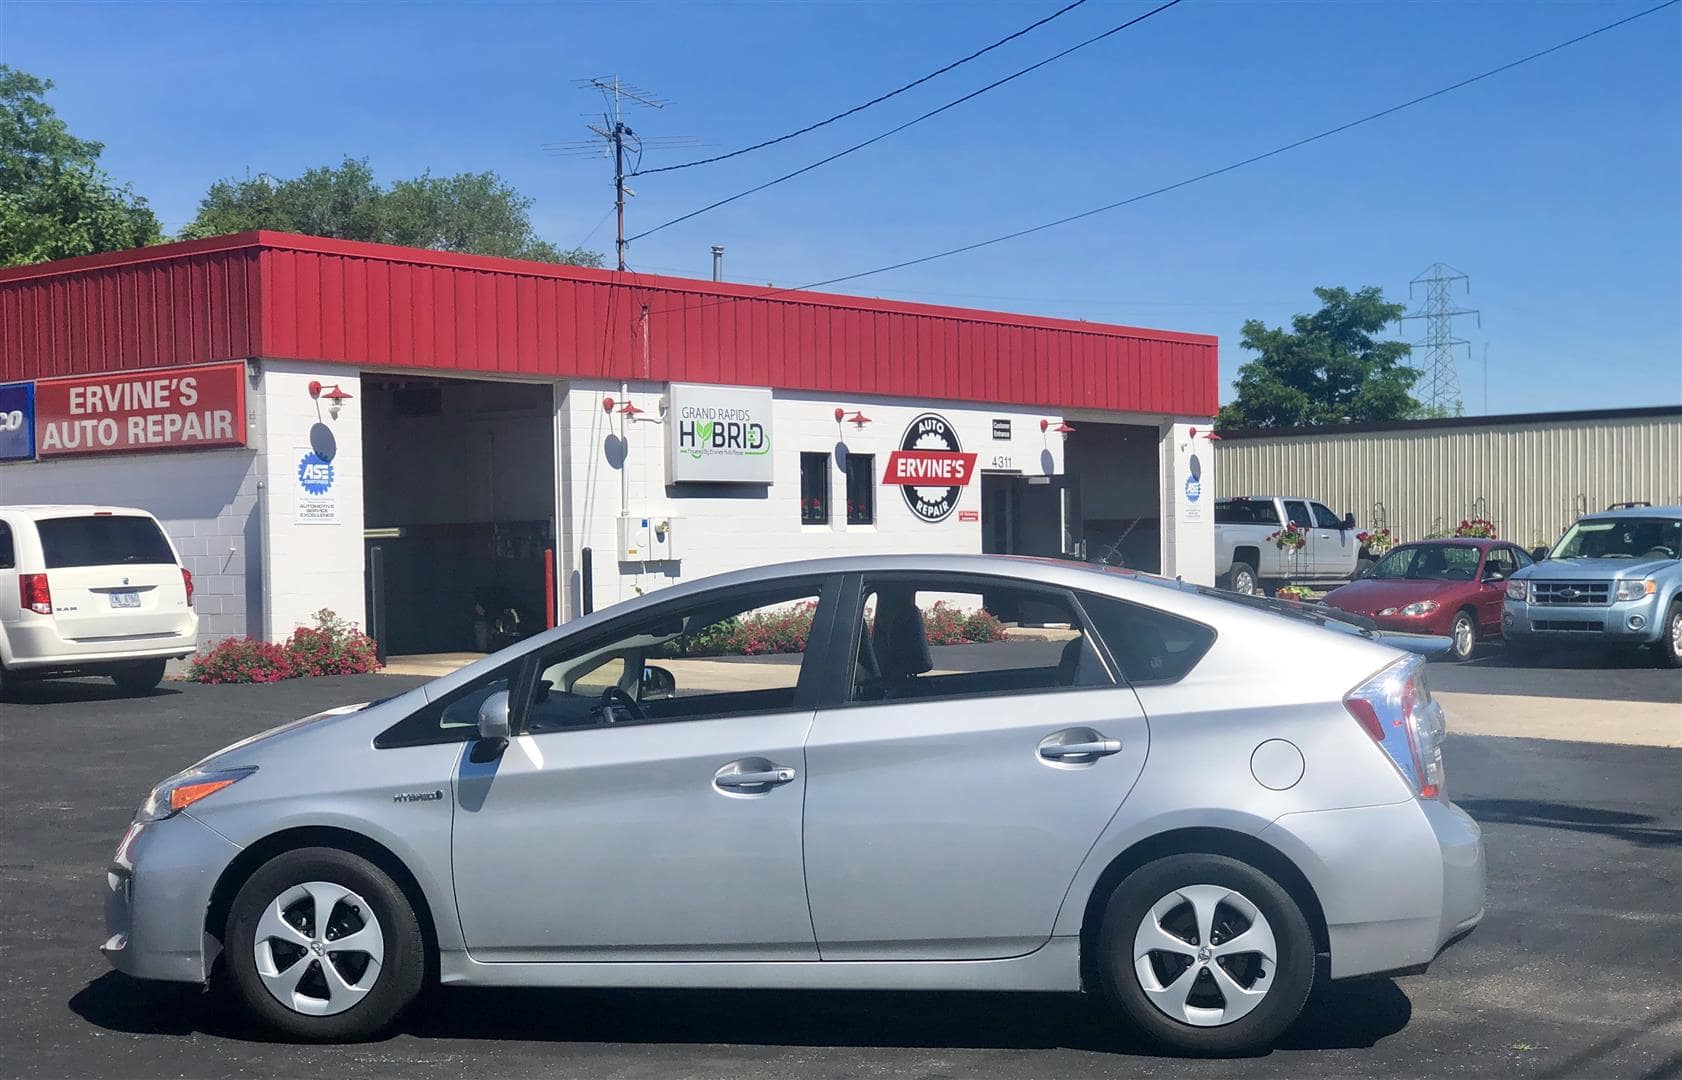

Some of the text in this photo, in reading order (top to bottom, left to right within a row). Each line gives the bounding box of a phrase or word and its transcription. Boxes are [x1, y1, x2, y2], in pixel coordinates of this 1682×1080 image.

[69, 377, 198, 415] ERVINE'S
[682, 407, 751, 421] GRAND RAPIDS
[42, 410, 233, 450] AUTO REPAIR
[679, 420, 764, 449] HYBRID
[919, 419, 945, 434] AUTO
[896, 458, 965, 479] ERVINE'S
[992, 456, 1012, 468] 4311
[302, 464, 329, 480] ASE
[915, 501, 950, 517] REPAIR
